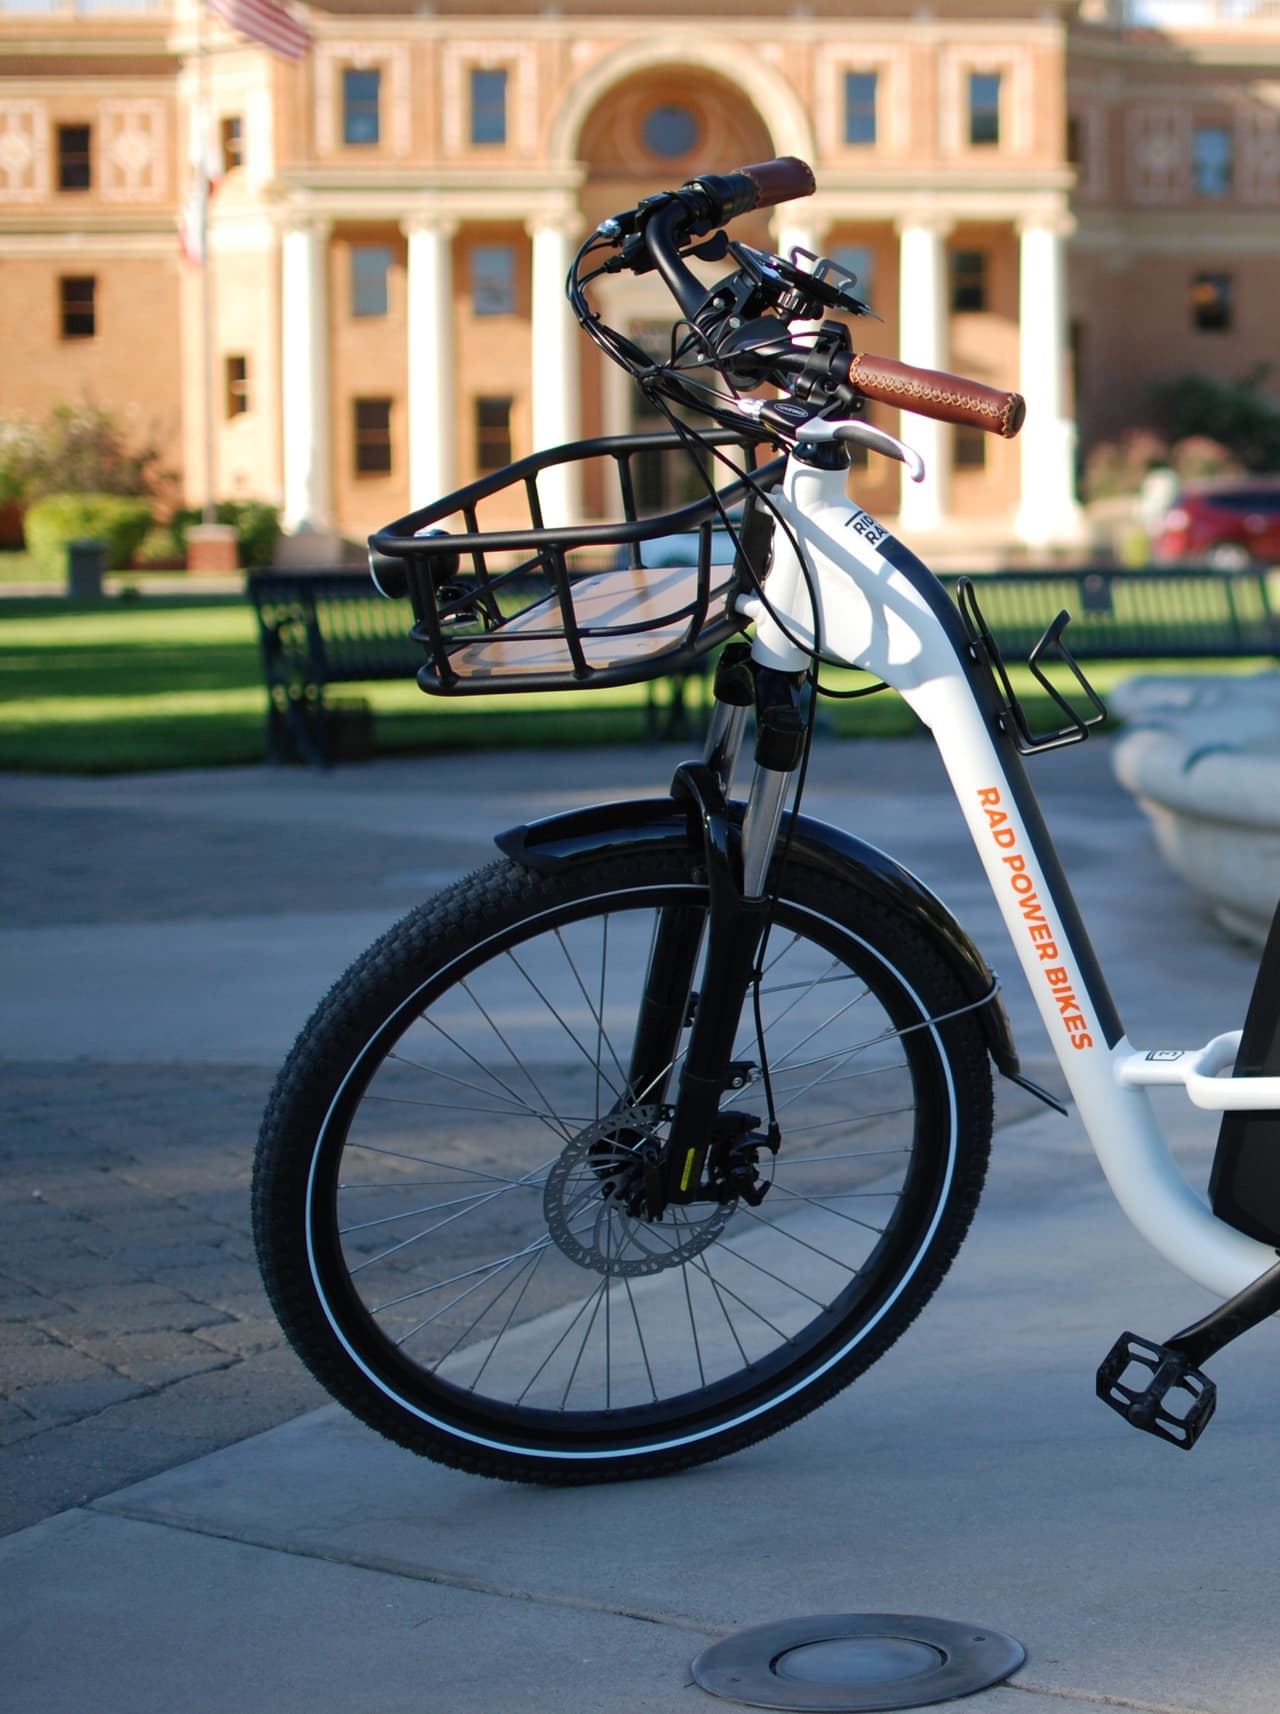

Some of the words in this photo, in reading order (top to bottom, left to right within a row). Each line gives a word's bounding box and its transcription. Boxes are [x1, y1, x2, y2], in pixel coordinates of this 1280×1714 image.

[976, 786, 1017, 849] RAD
[1002, 854, 1059, 961] POWER
[1045, 967, 1093, 1051] BIKES
